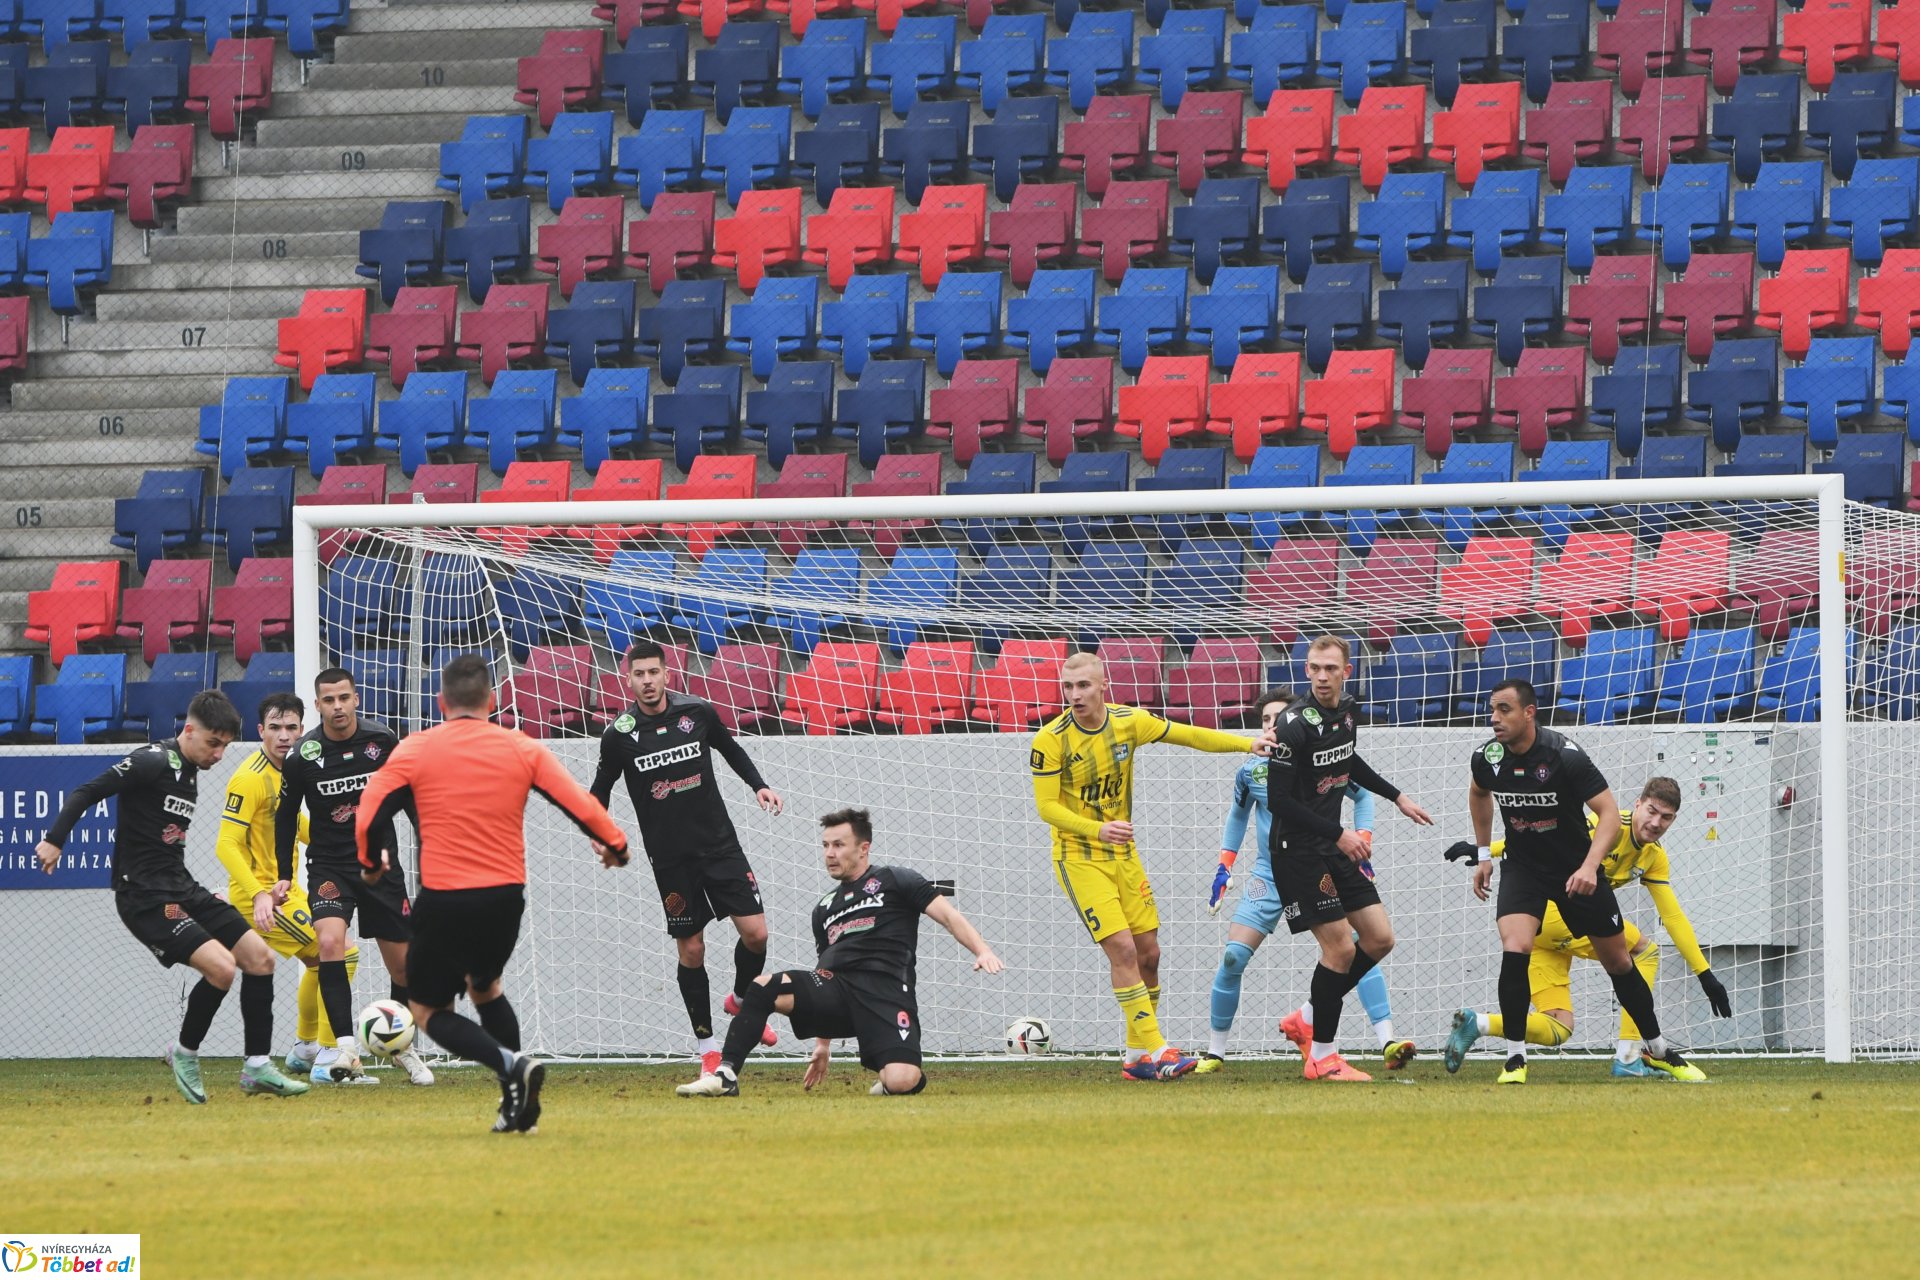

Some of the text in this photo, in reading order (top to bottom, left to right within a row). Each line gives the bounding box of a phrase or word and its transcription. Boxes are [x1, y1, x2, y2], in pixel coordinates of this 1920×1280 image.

[421, 66, 445, 87] 10
[341, 151, 366, 171] 09
[262, 239, 287, 259] 08
[181, 327, 207, 347] 07
[99, 416, 125, 436] 06
[16, 506, 42, 528] 05
[0, 790, 109, 819] EDIA
[293, 909, 314, 927] 9
[1084, 906, 1101, 932] 5
[896, 1010, 911, 1029] 6
